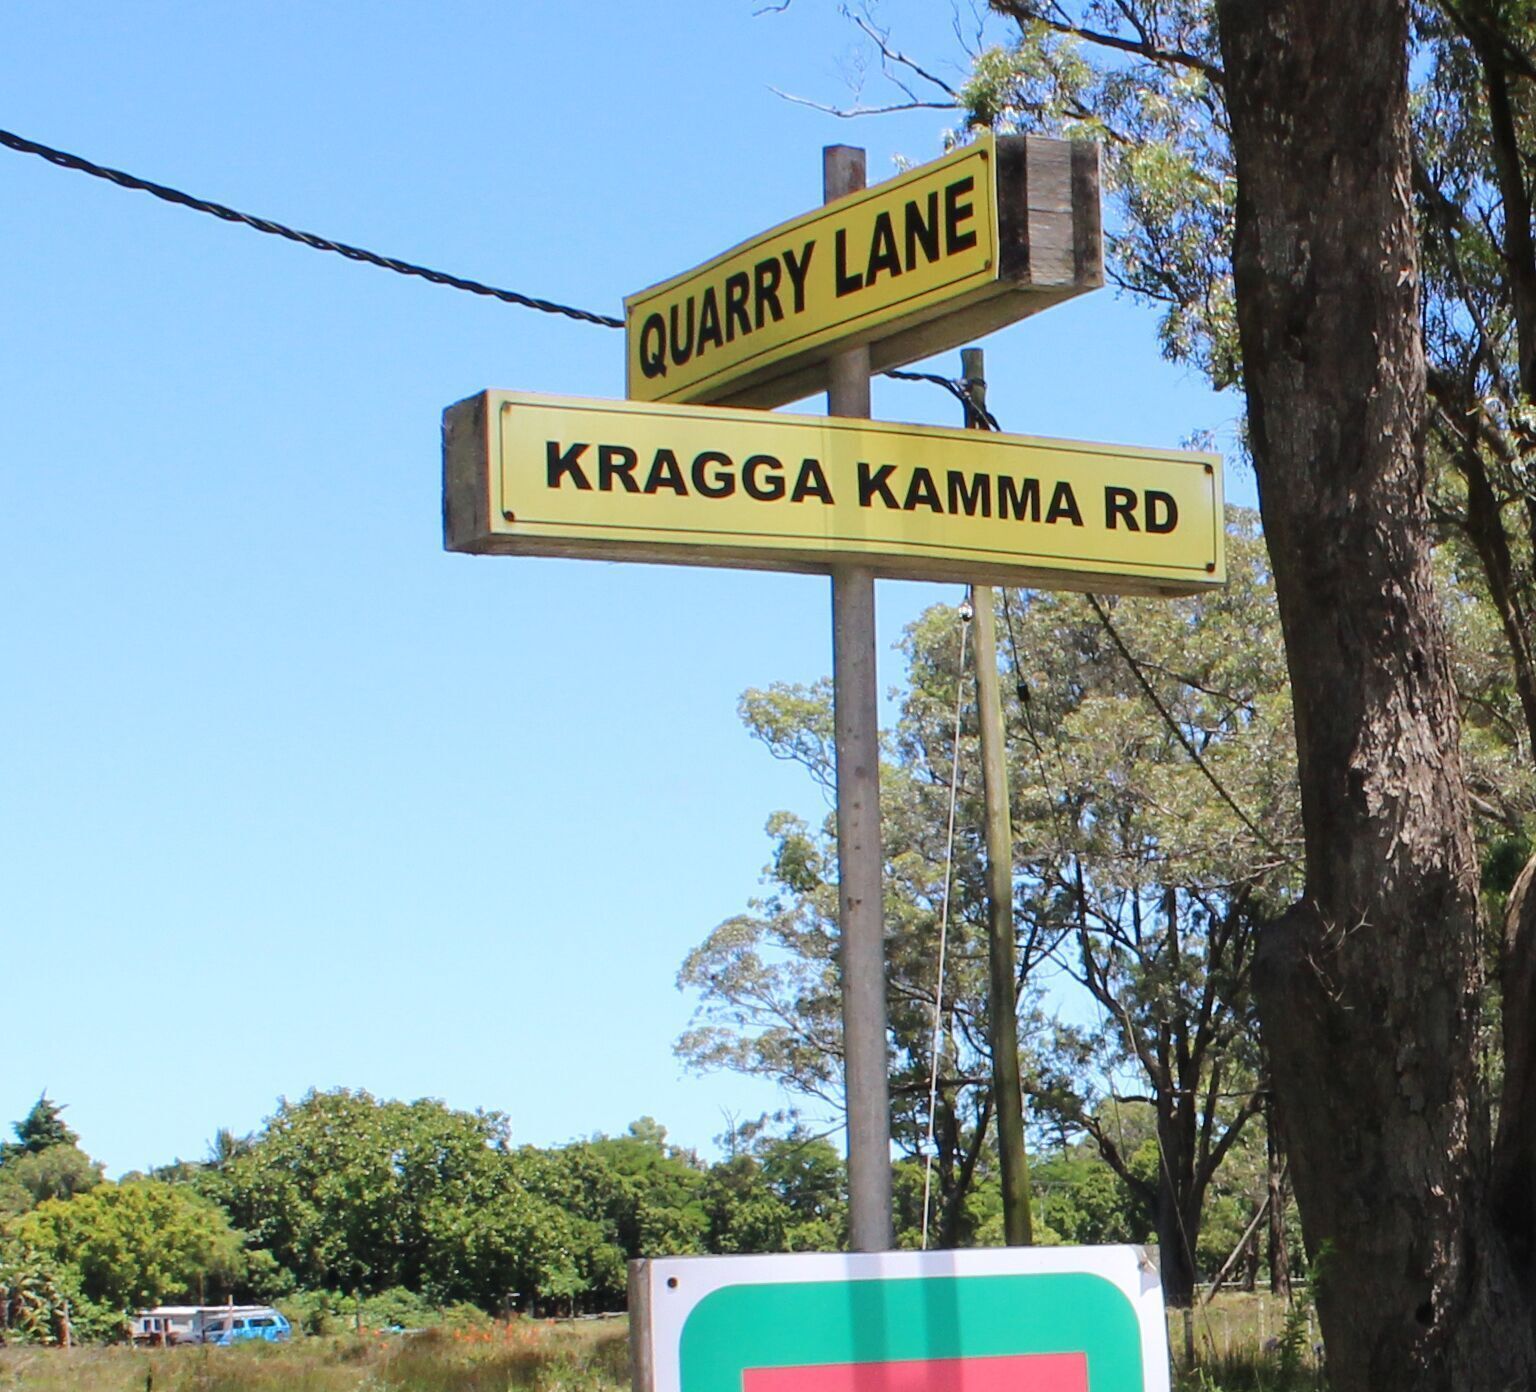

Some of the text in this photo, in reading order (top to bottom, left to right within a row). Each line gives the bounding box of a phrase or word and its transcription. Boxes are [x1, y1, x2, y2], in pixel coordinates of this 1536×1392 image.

[638, 176, 979, 380] QUARRY LANE
[545, 440, 1179, 534] KRAGGA KAMMA RD
